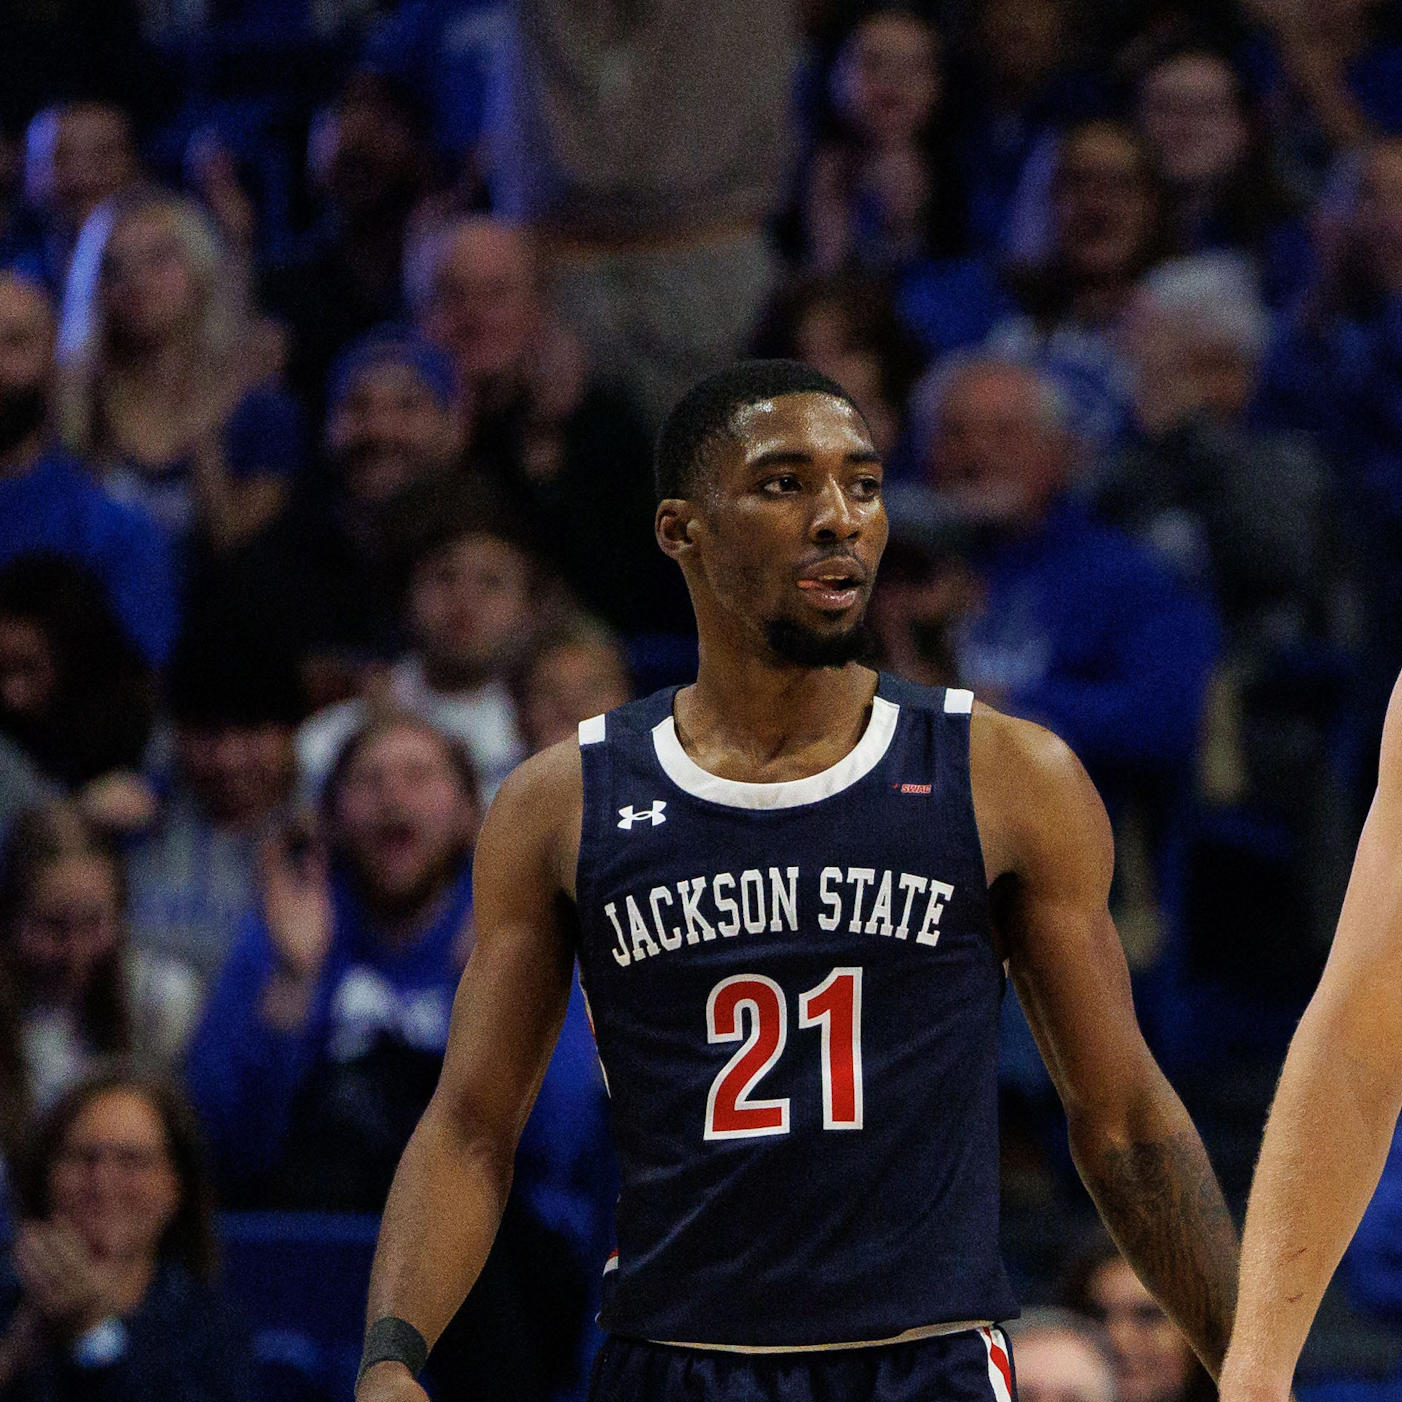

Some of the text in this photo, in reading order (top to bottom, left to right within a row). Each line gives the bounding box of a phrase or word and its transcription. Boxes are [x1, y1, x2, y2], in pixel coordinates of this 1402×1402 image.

[900, 783, 932, 794] SWAC
[604, 866, 955, 967] JACKSON STATE
[703, 967, 863, 1141] 21
